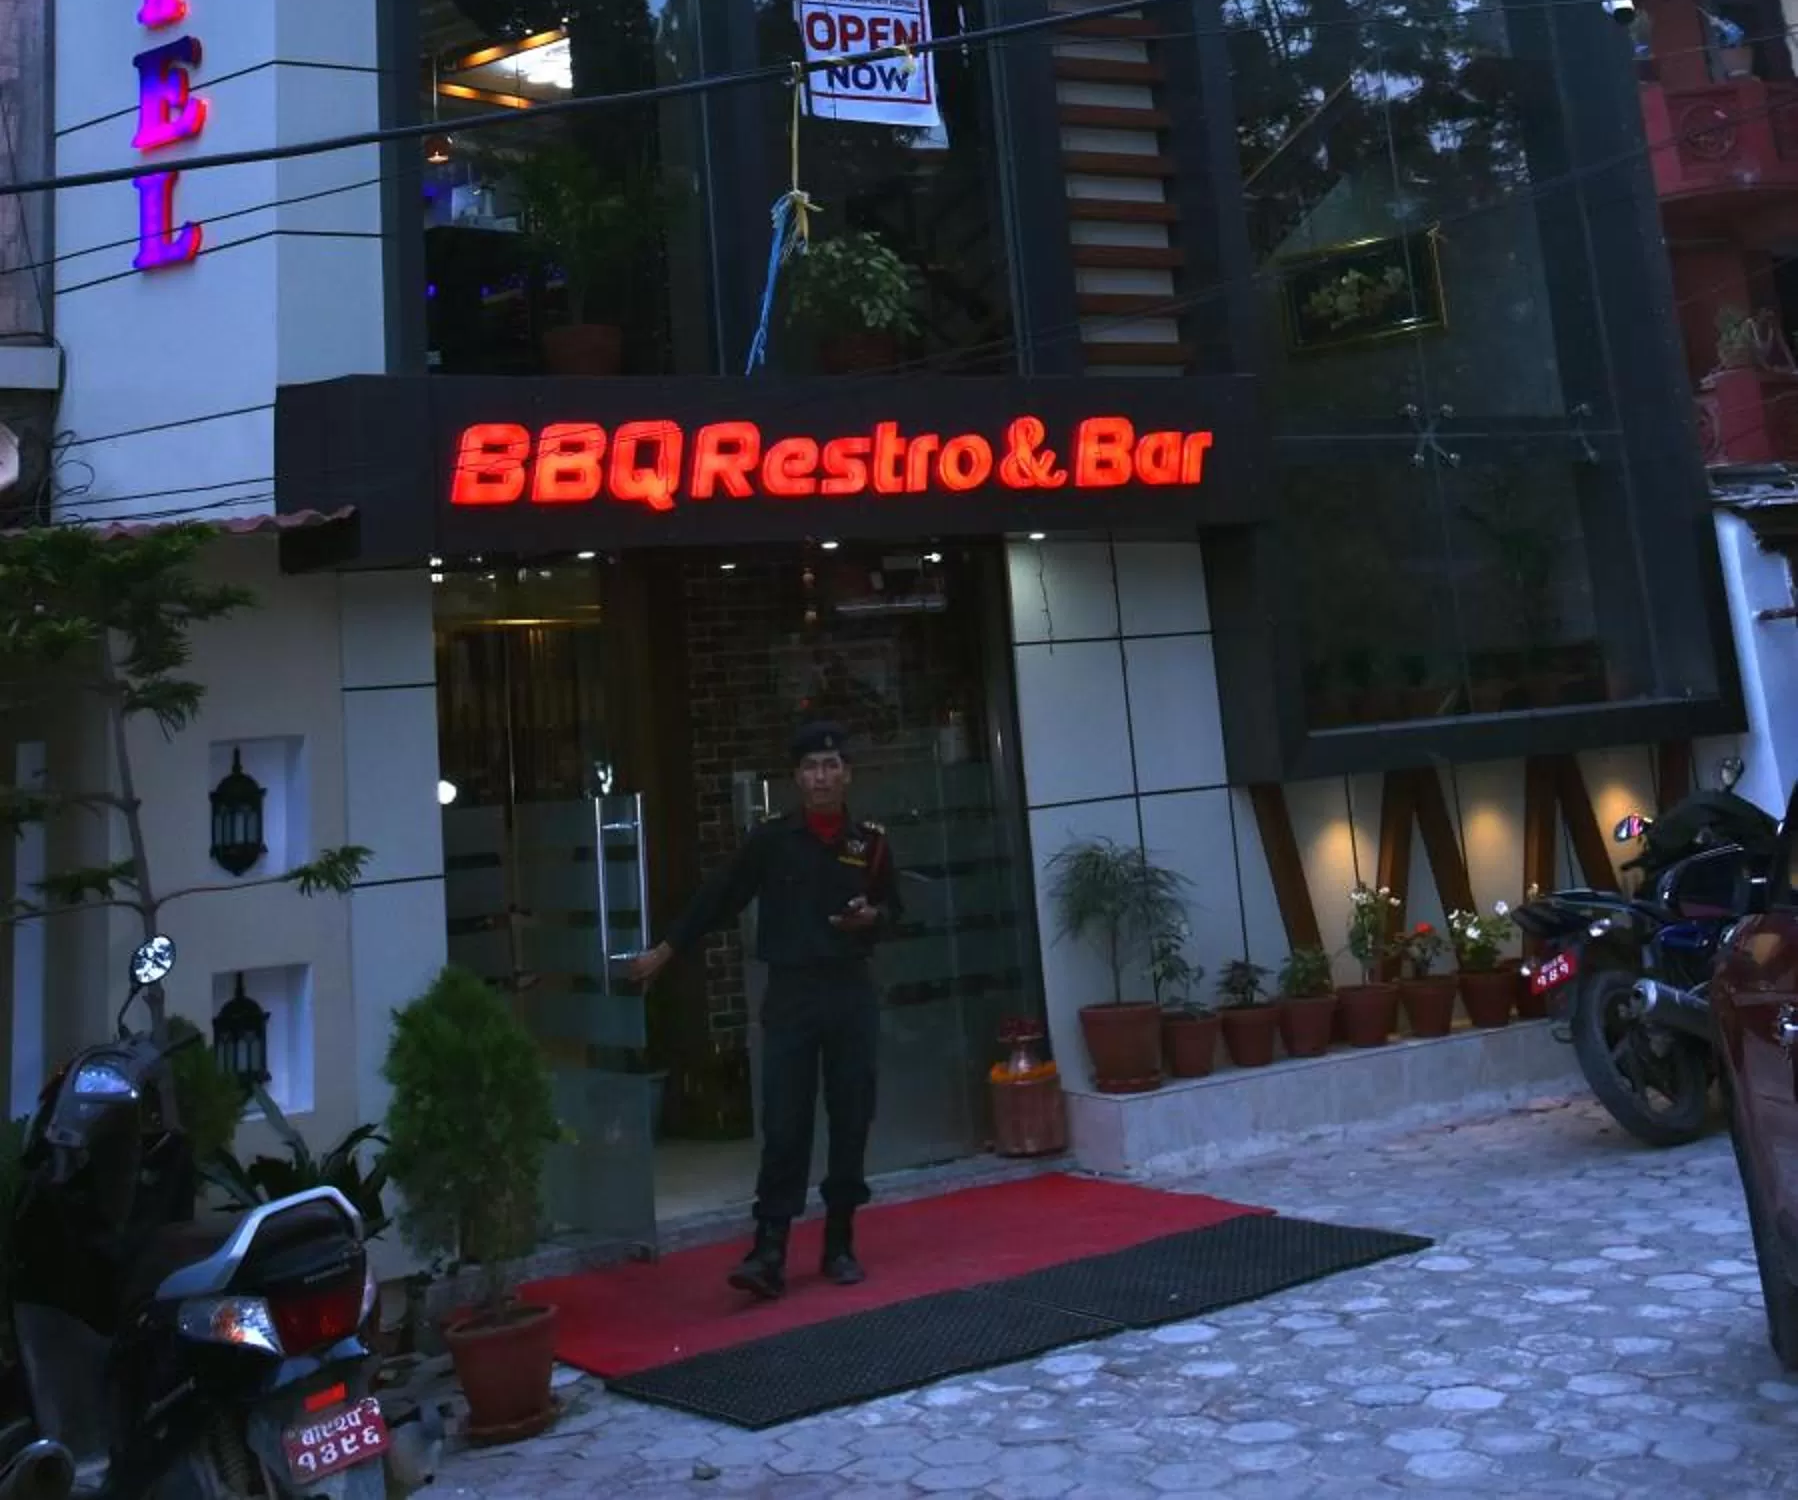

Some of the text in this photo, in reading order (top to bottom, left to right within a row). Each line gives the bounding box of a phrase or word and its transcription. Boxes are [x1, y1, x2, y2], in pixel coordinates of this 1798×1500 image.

[806, 11, 919, 54] OPEN
[826, 62, 910, 92] NOW
[450, 415, 1214, 511] BBQ Restro & Bar
